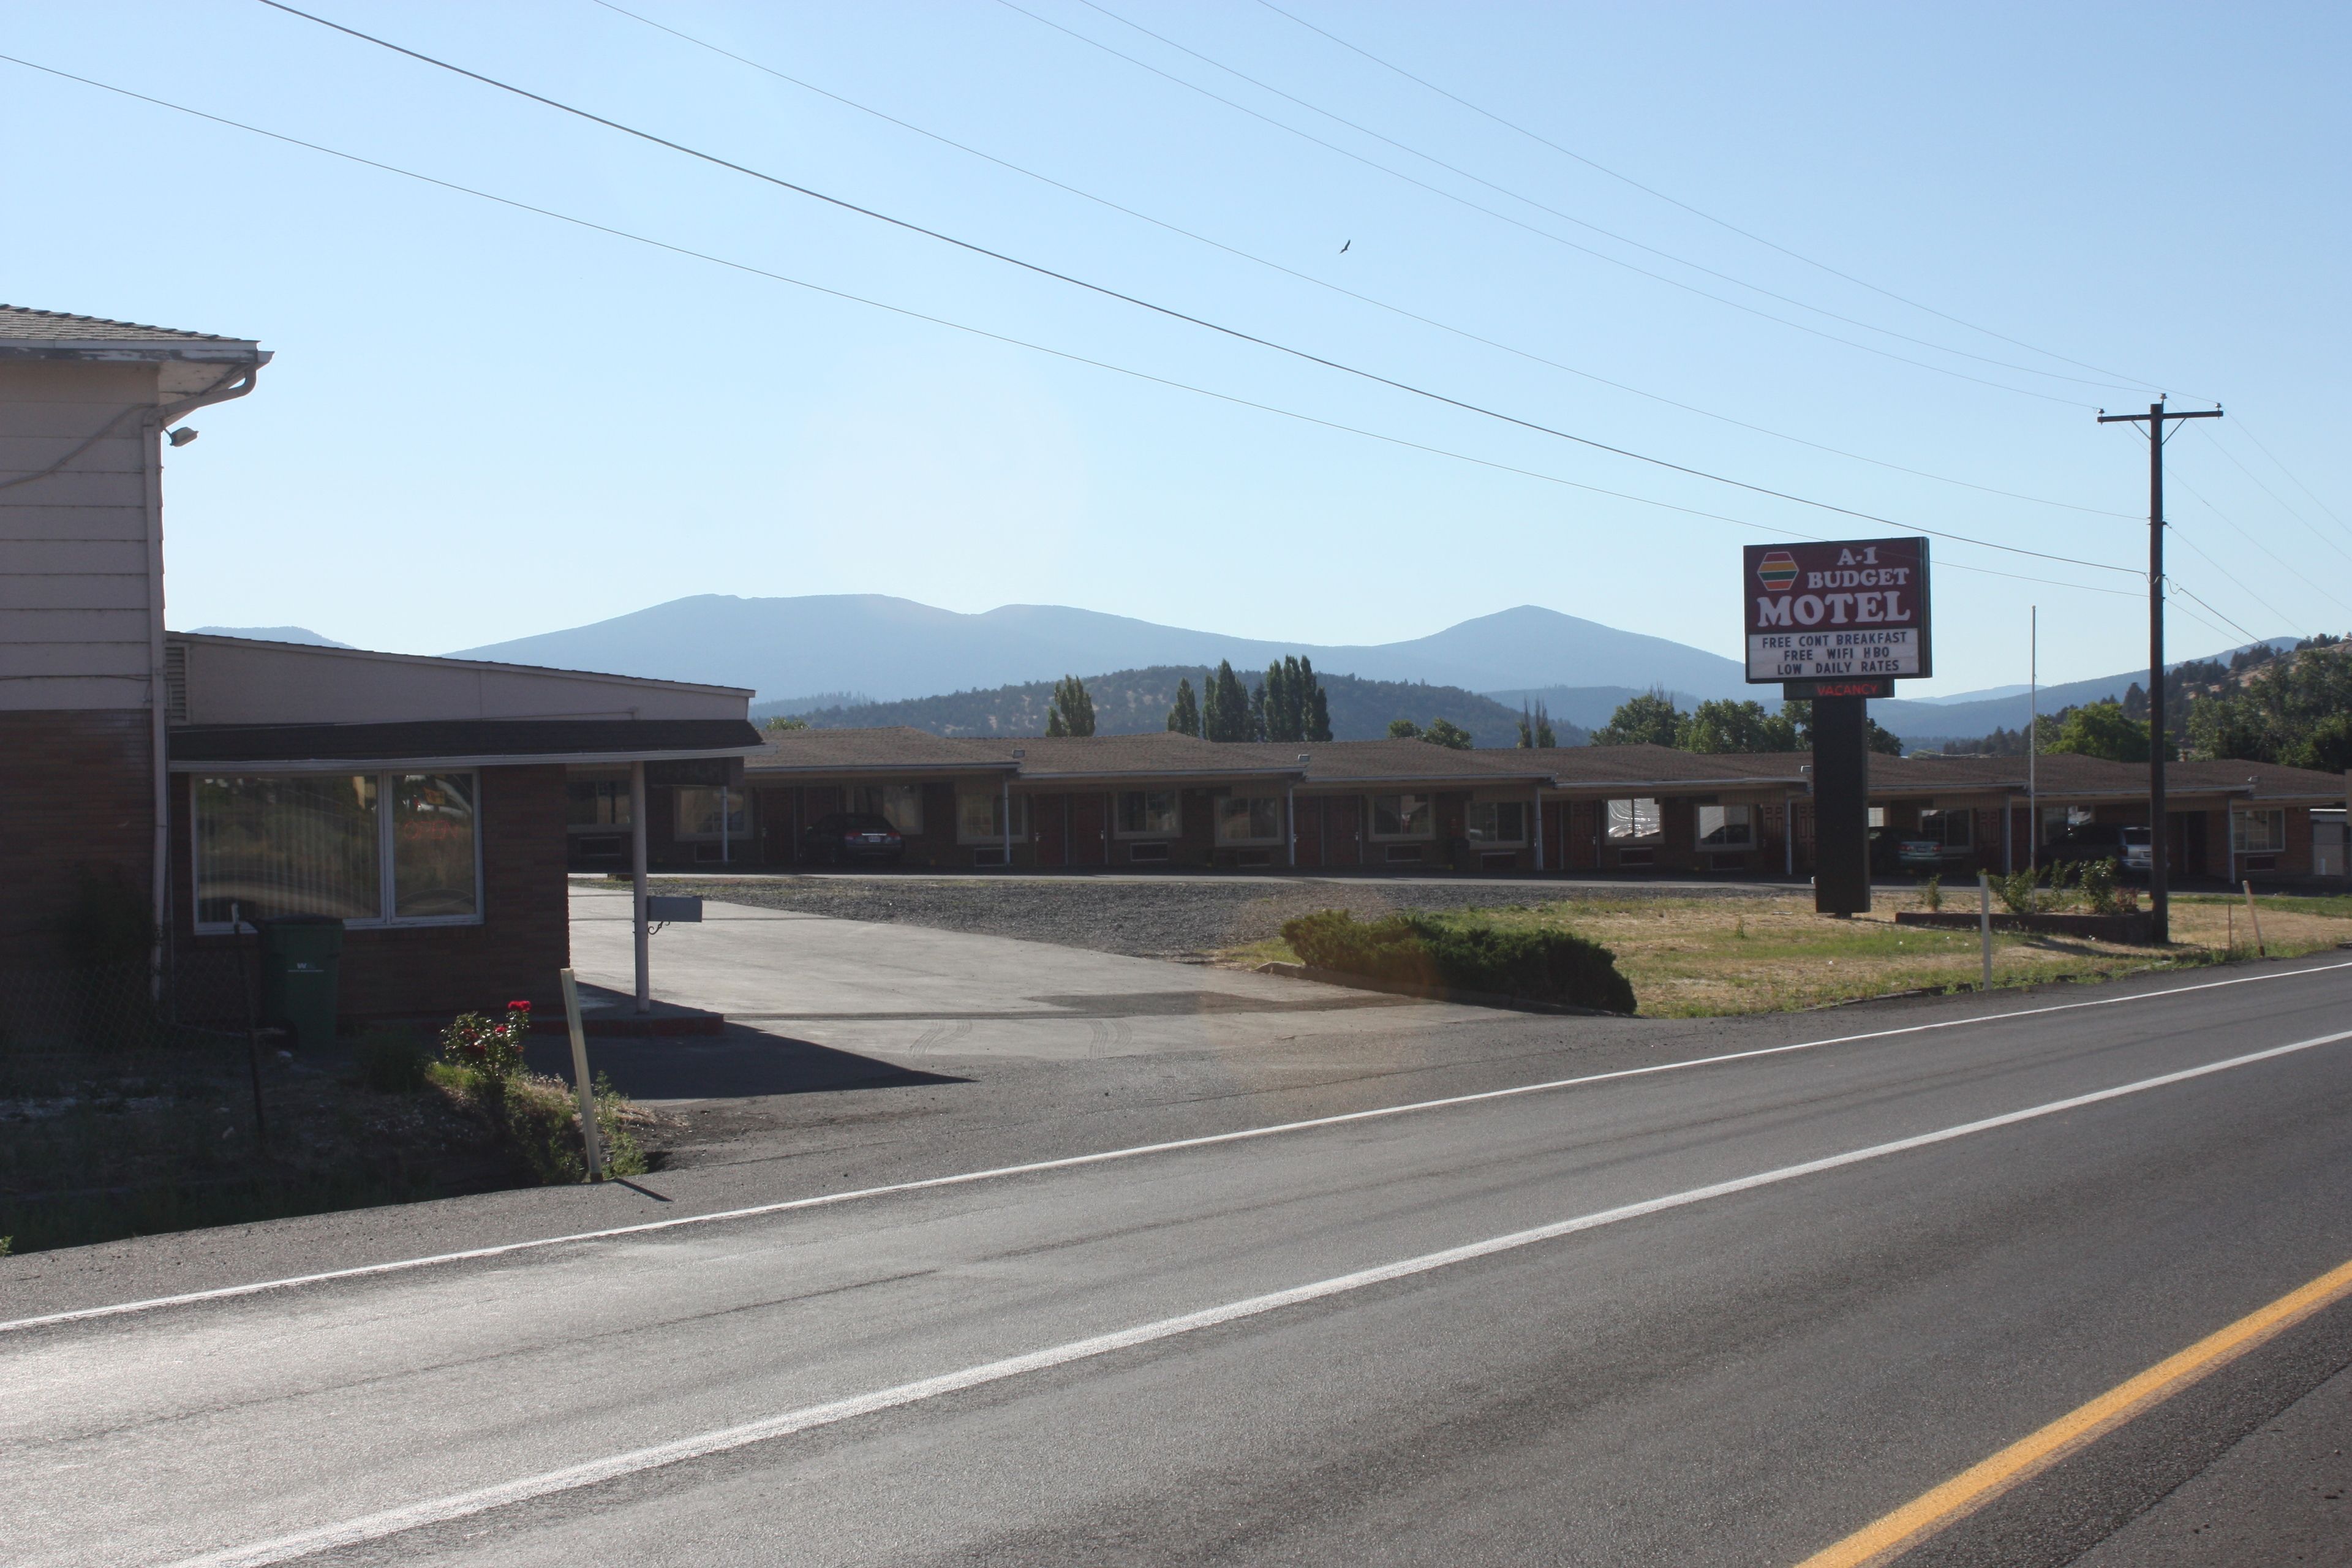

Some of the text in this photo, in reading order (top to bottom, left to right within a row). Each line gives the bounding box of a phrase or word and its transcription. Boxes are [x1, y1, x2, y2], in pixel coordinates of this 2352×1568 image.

[1837, 547, 1879, 565] A-1
[1807, 568, 1909, 589] BUDGET
[1757, 591, 1910, 627] MOTEL
[1762, 631, 1907, 649] FREE CONT BREAKFAST
[1784, 647, 1890, 662] FREE WIFI HBO
[1777, 660, 1899, 675] LOW DAILY RATES
[1817, 683, 1878, 696] VACANCY
[404, 820, 459, 840] OPEN
